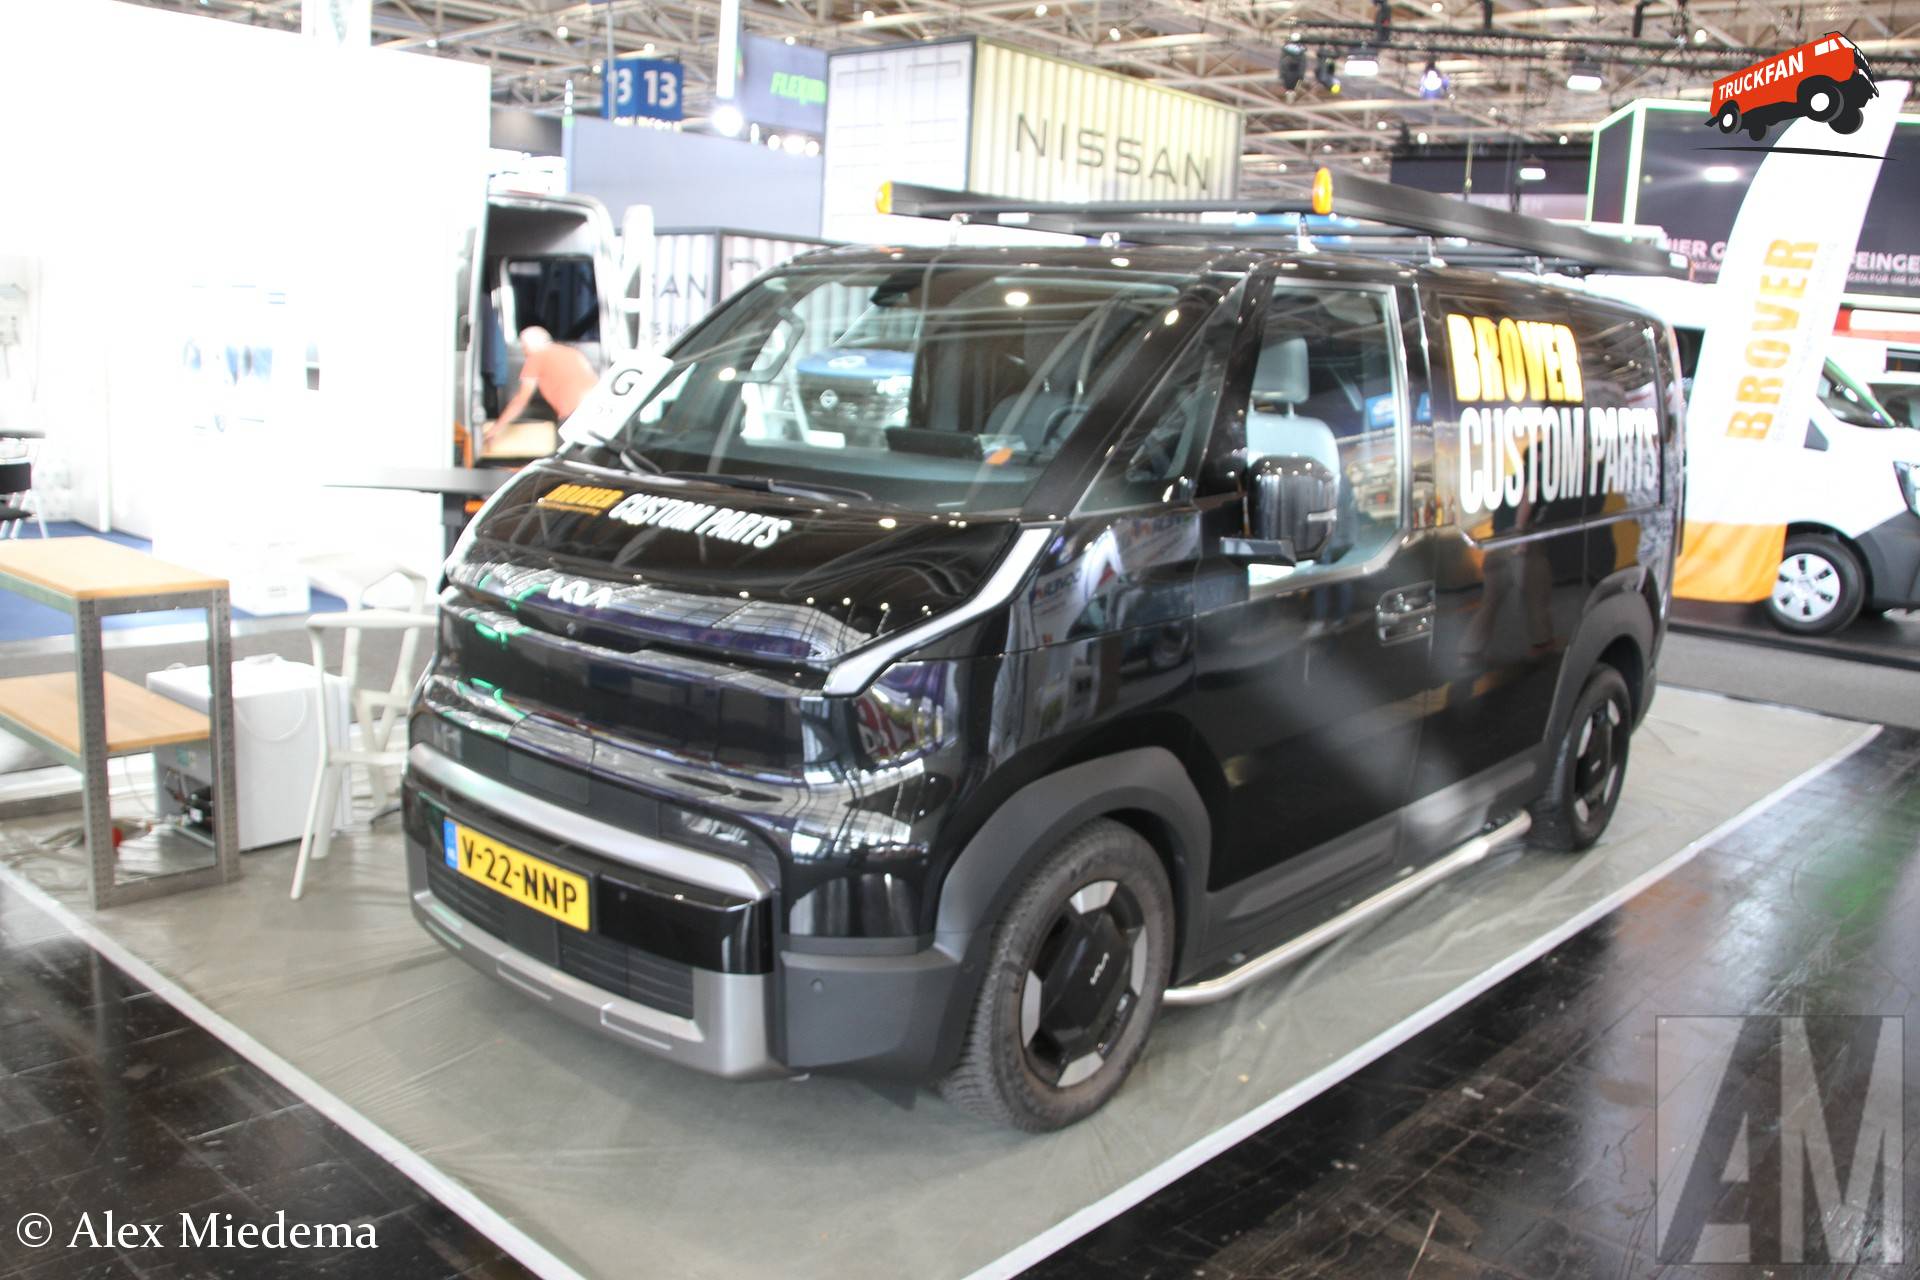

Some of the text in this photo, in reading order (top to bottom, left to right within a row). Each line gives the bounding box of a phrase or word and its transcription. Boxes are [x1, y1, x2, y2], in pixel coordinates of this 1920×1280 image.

[643, 70, 678, 108] 13
[1016, 113, 1209, 190] NISSAN
[1446, 313, 1584, 404] BROVER
[1724, 239, 1819, 441] BROVER
[1459, 406, 1659, 514] CUSTOM PARTS
[608, 493, 716, 532] CUSTOM
[695, 506, 793, 549] PARTS
[462, 835, 577, 914] V-22-NNP
